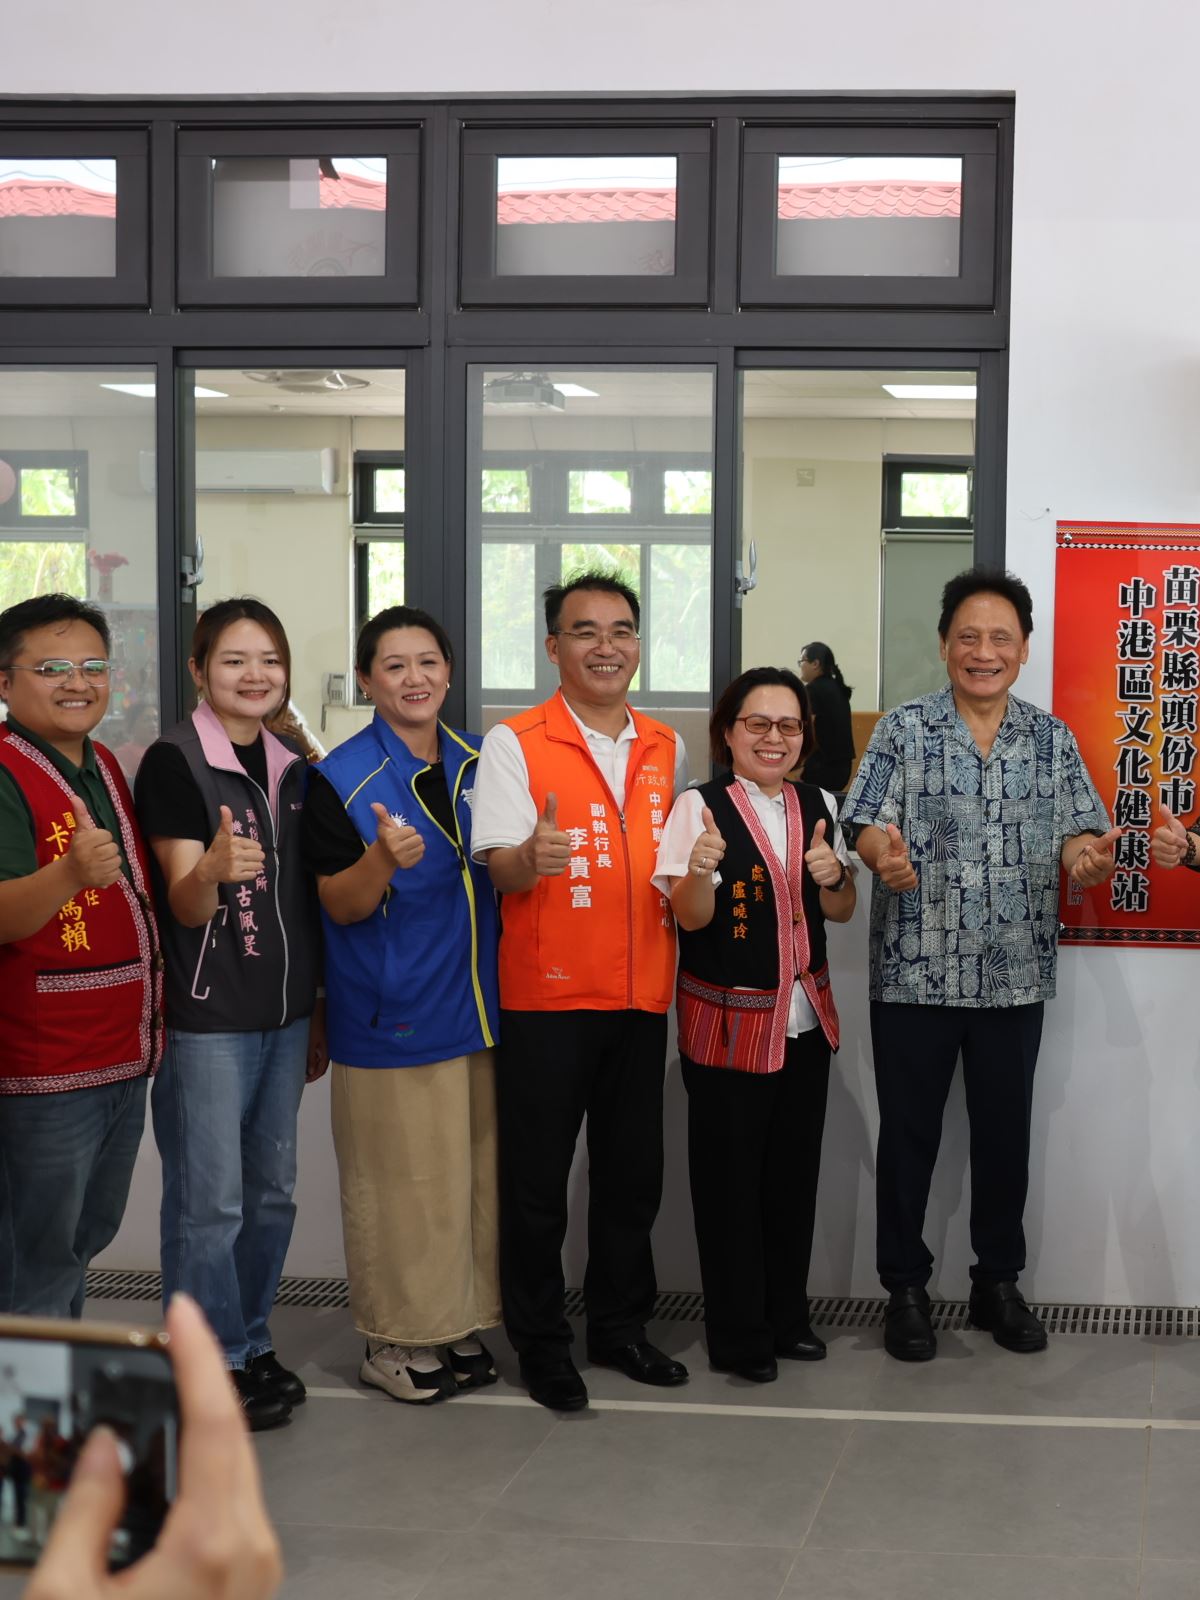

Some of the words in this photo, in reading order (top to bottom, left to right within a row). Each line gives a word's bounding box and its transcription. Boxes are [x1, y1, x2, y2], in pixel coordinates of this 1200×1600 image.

[1160, 565, 1200, 816] 苗栗縣頭份市
[1111, 578, 1156, 913] 中港區文化健康站
[246, 808, 268, 892] 頭份所
[566, 827, 592, 909] 李貴富
[590, 803, 612, 868] 副執行長
[649, 791, 670, 928] 中部聯中心
[236, 885, 261, 957] 古佩旻
[732, 880, 748, 939] 盧曉玲
[752, 864, 765, 902] 處長
